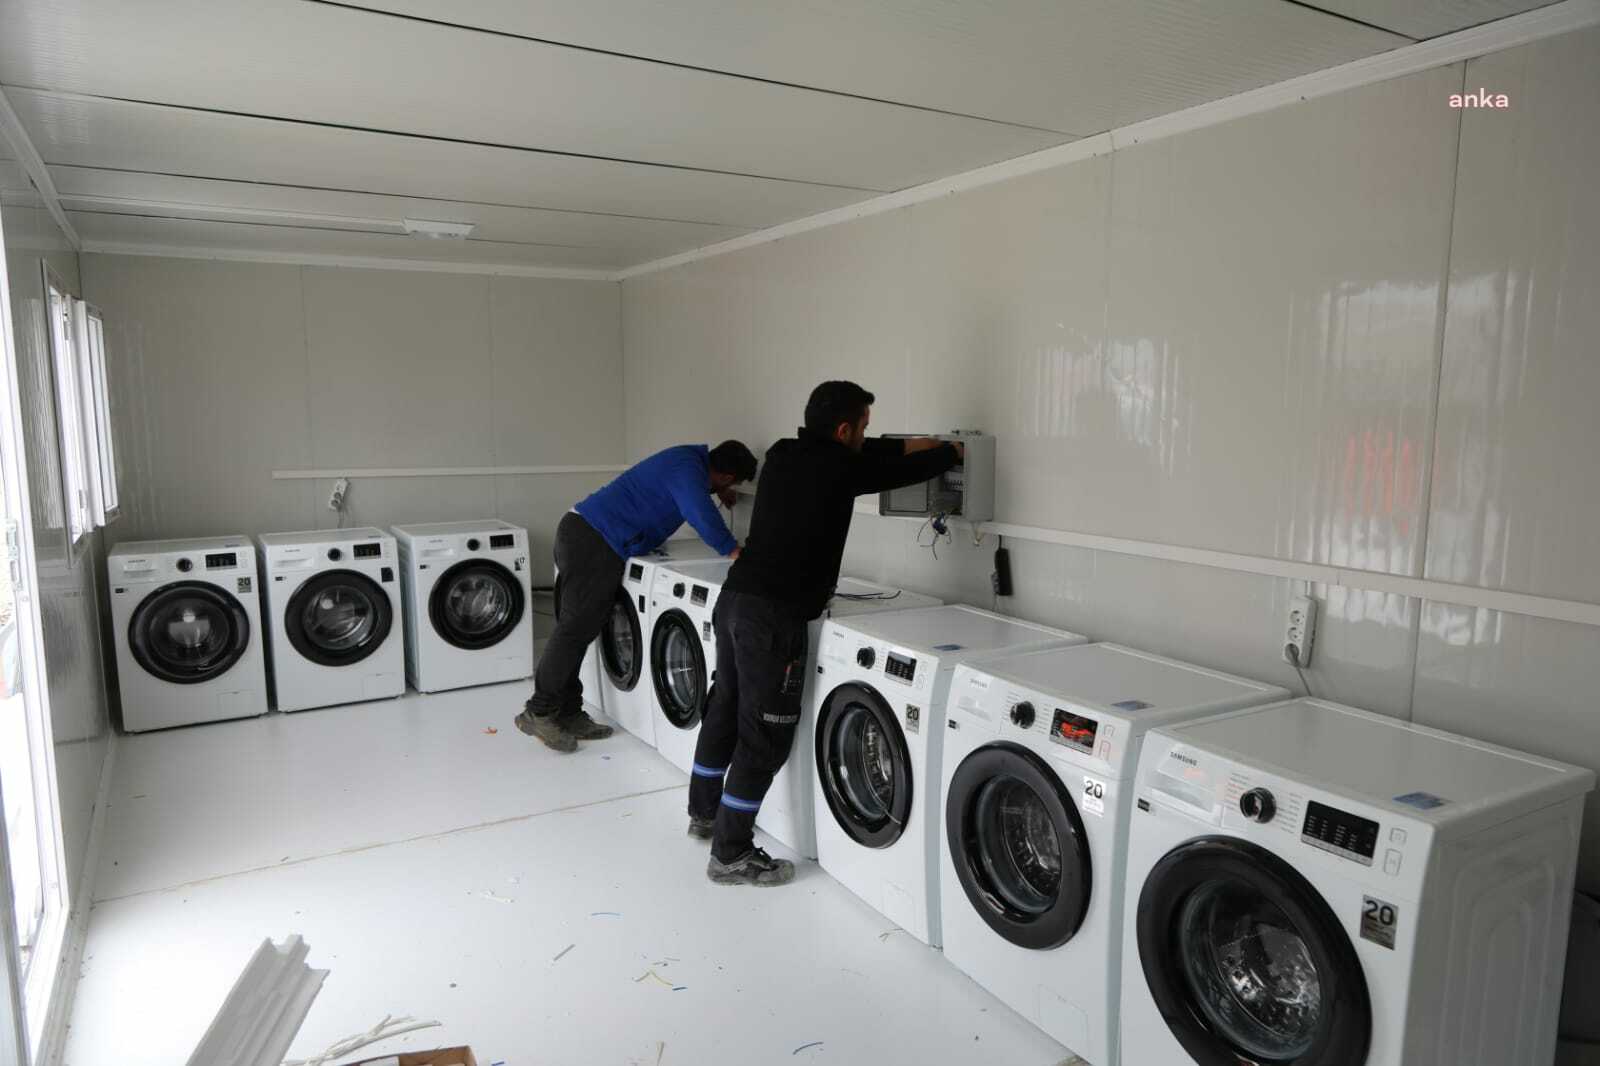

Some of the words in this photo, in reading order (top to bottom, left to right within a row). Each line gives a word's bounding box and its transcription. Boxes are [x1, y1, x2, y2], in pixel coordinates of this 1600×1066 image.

[906, 706, 919, 721] 20
[1085, 780, 1103, 799] 20
[1366, 900, 1394, 926] 20
